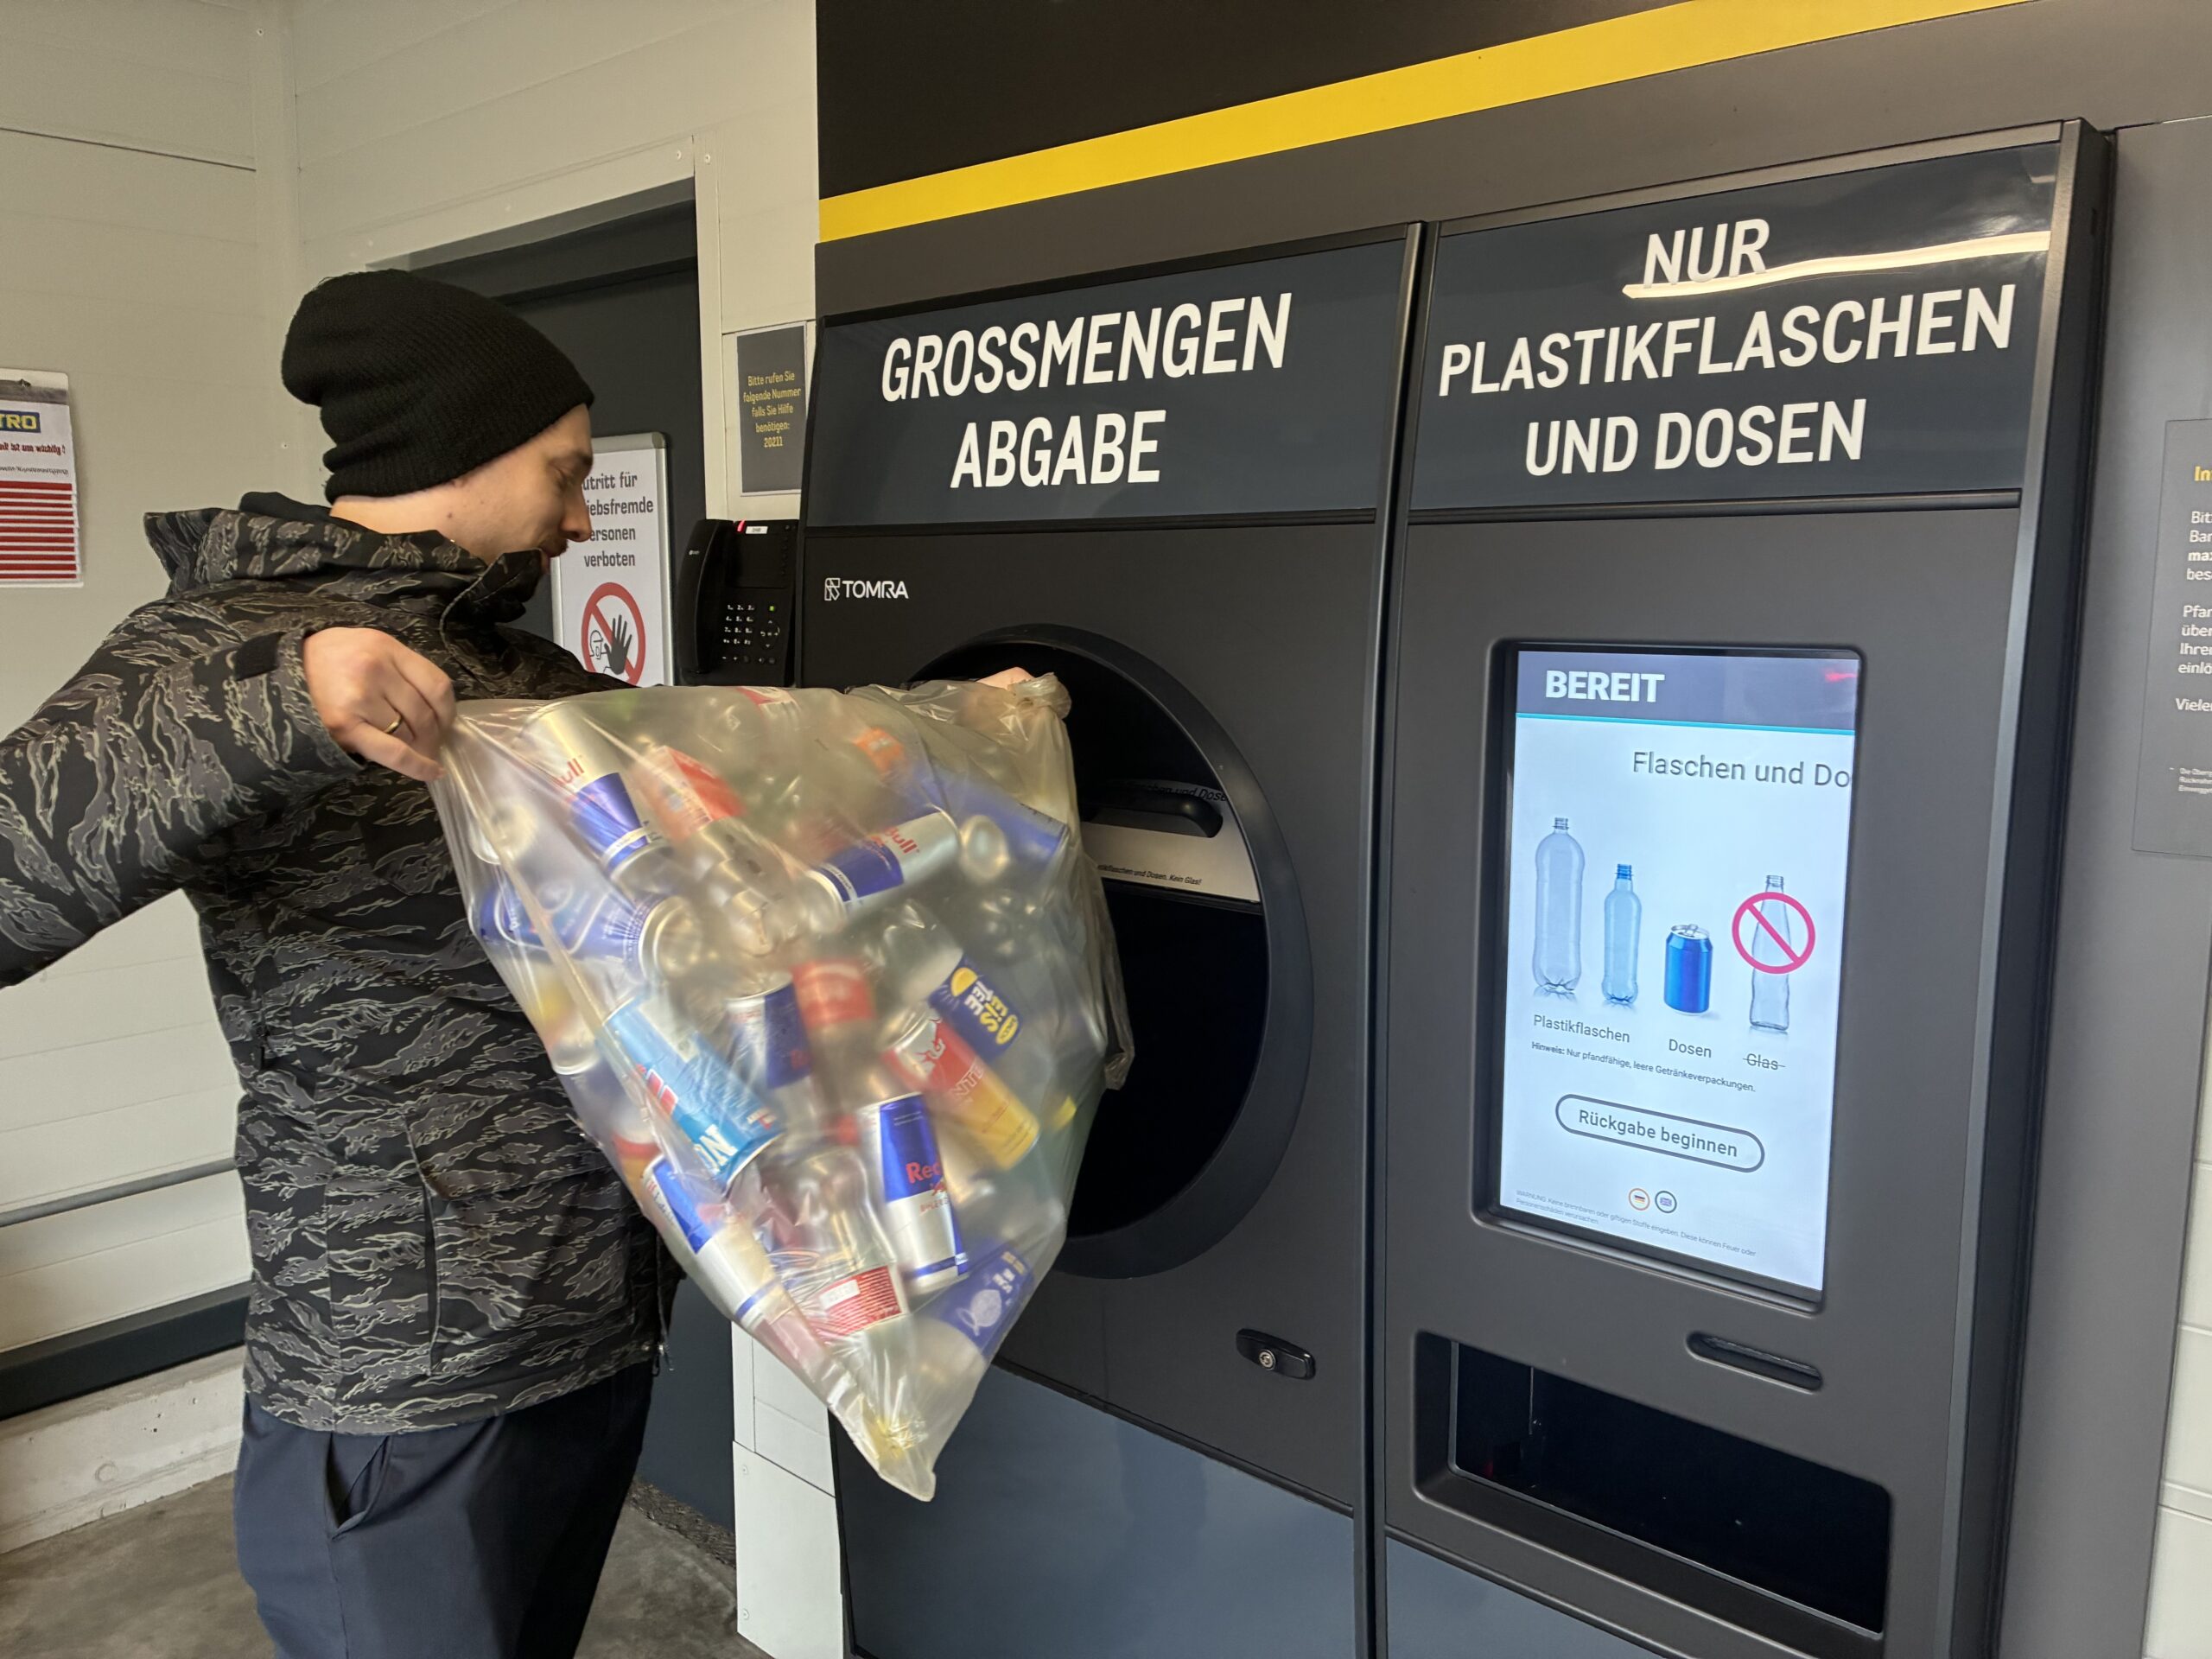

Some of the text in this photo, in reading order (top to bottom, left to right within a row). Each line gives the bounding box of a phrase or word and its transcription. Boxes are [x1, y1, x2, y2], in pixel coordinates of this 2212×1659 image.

[1643, 219, 1770, 288] NUR
[881, 292, 1293, 402] GROSSMENGEN
[1440, 284, 2016, 397] PLASTIKFLASCHEN
[747, 370, 796, 387] Bitte rufen Sie
[743, 388, 801, 404] folgende Nummer
[751, 403, 794, 417] falls Sie Hilfe
[755, 421, 791, 434] benötigen:
[1525, 398, 1867, 476] UND DOSEN
[950, 410, 1166, 488] ABGABE
[582, 472, 638, 491] utritt für
[587, 495, 654, 516] iebsfremde
[589, 527, 636, 542] ersonen
[584, 550, 636, 568] verboten
[2186, 568, 2212, 581] bes
[842, 580, 909, 599] TOMRA
[1545, 671, 1665, 702] BEREIT
[2175, 697, 2212, 711] Viele
[1632, 751, 1850, 788] Flaschen und Do
[1533, 1014, 1630, 1043] Plastikflaschen
[1669, 1039, 1712, 1058] Dosen
[1531, 1040, 1757, 1092] Hinweis: Nur pfandfähige, leere Getränkeverpackungen.
[1745, 1052, 1779, 1071] Glas
[1579, 1109, 1738, 1158] Rückgabe beginnen
